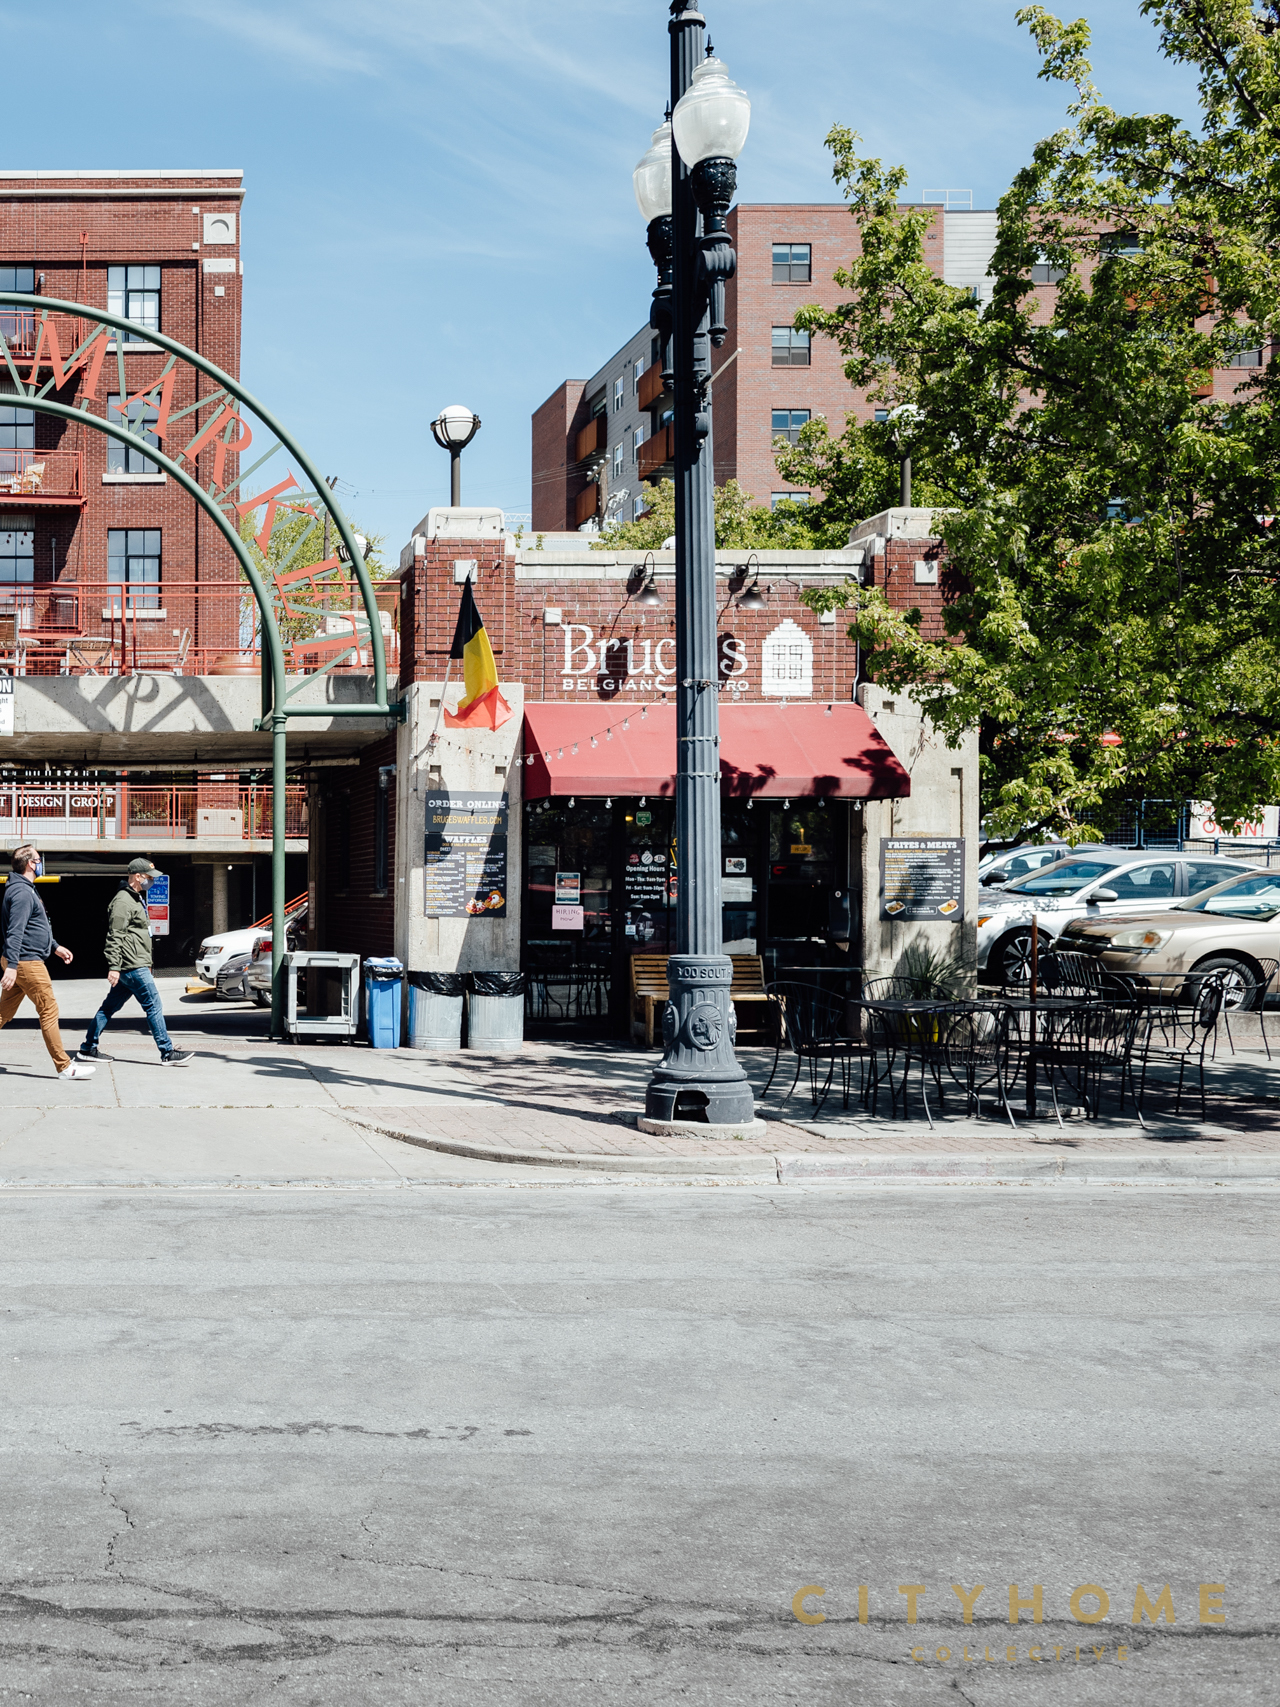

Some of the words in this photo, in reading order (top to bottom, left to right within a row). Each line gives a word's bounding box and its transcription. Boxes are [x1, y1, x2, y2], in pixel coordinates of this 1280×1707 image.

[20, 319, 363, 670] MARKET
[560, 624, 749, 691] Brugs
[562, 678, 652, 691] BELGIAN
[18, 796, 63, 807] DESIGN
[71, 796, 114, 807] GROP
[428, 799, 463, 808] ORDER
[467, 800, 506, 809] ONLINE
[1202, 819, 1264, 837] OEN!
[444, 835, 488, 844] WAFFLES
[887, 841, 920, 849] FRITES
[927, 841, 957, 849] MEATS
[625, 865, 649, 873] Opening
